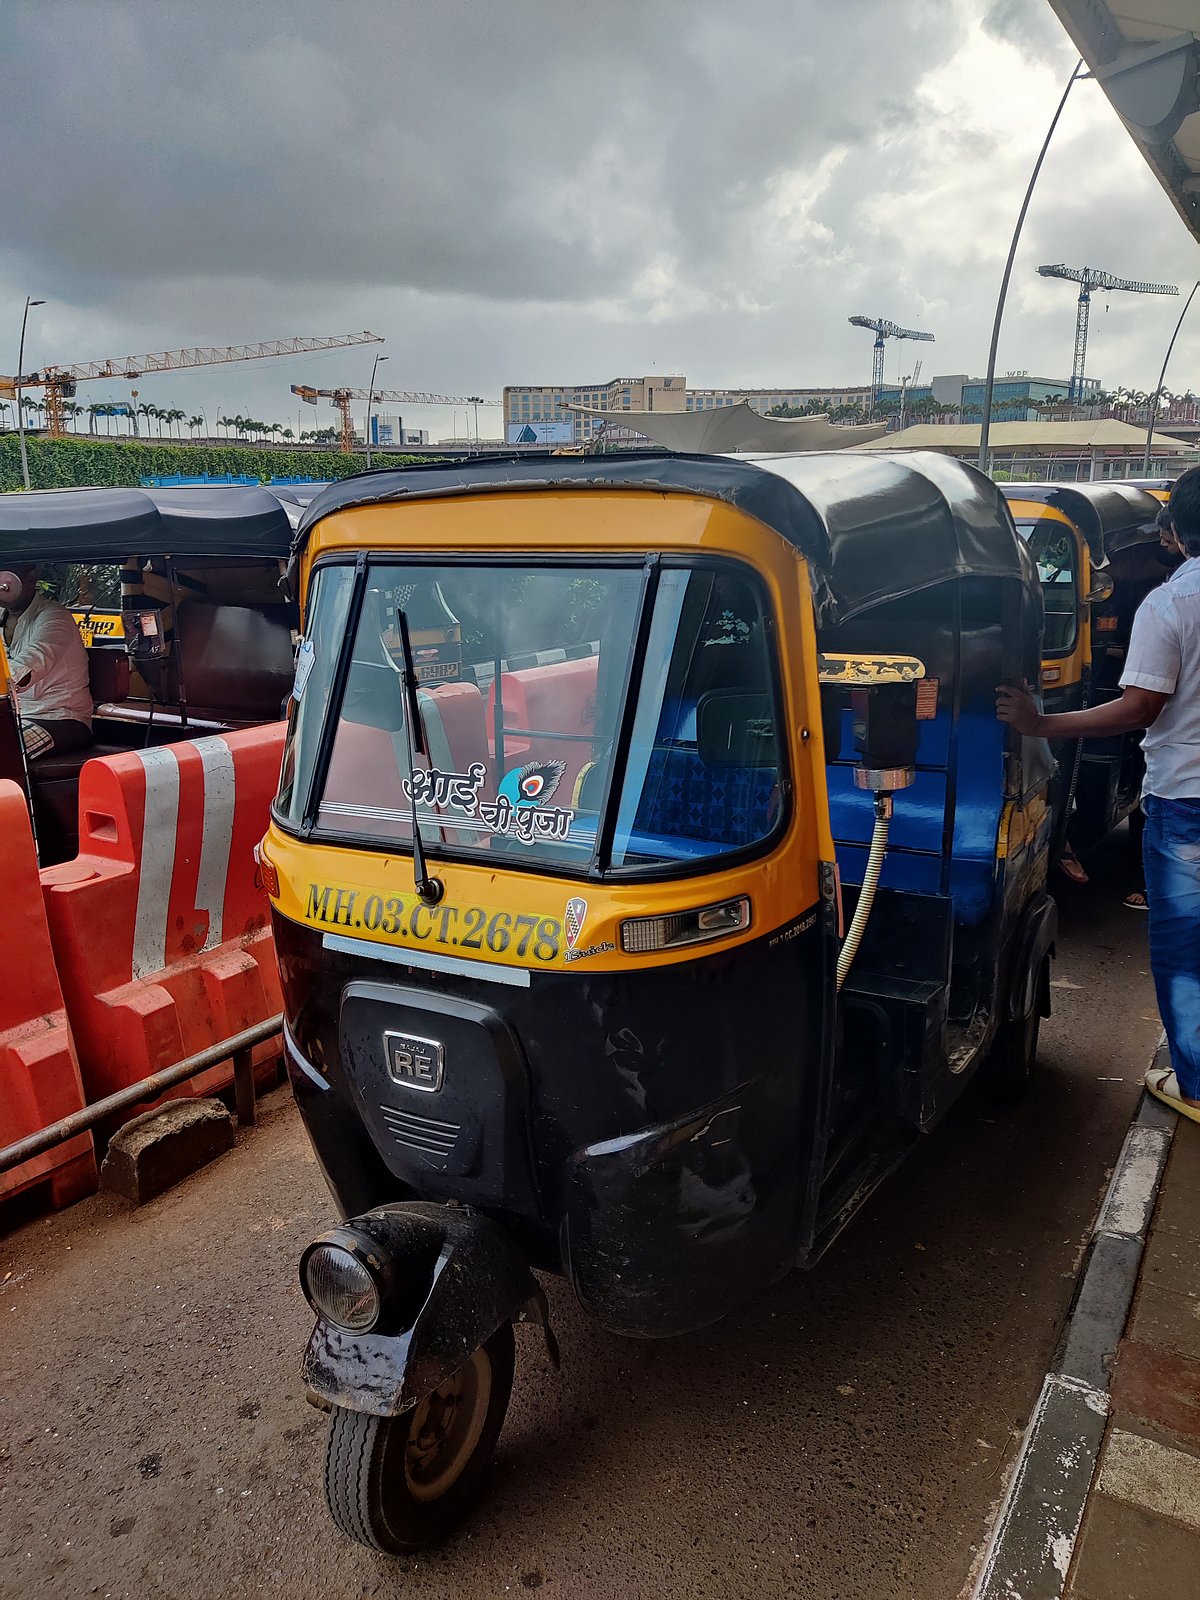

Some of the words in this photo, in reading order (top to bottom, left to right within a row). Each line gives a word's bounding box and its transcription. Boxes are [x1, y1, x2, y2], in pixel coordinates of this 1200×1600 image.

[402, 763, 486, 815] आई
[480, 795, 513, 833] ची
[305, 884, 562, 962] MH.03.CT.2678
[395, 1050, 432, 1080] RE
[400, 1043, 426, 1054] BAJAJ
